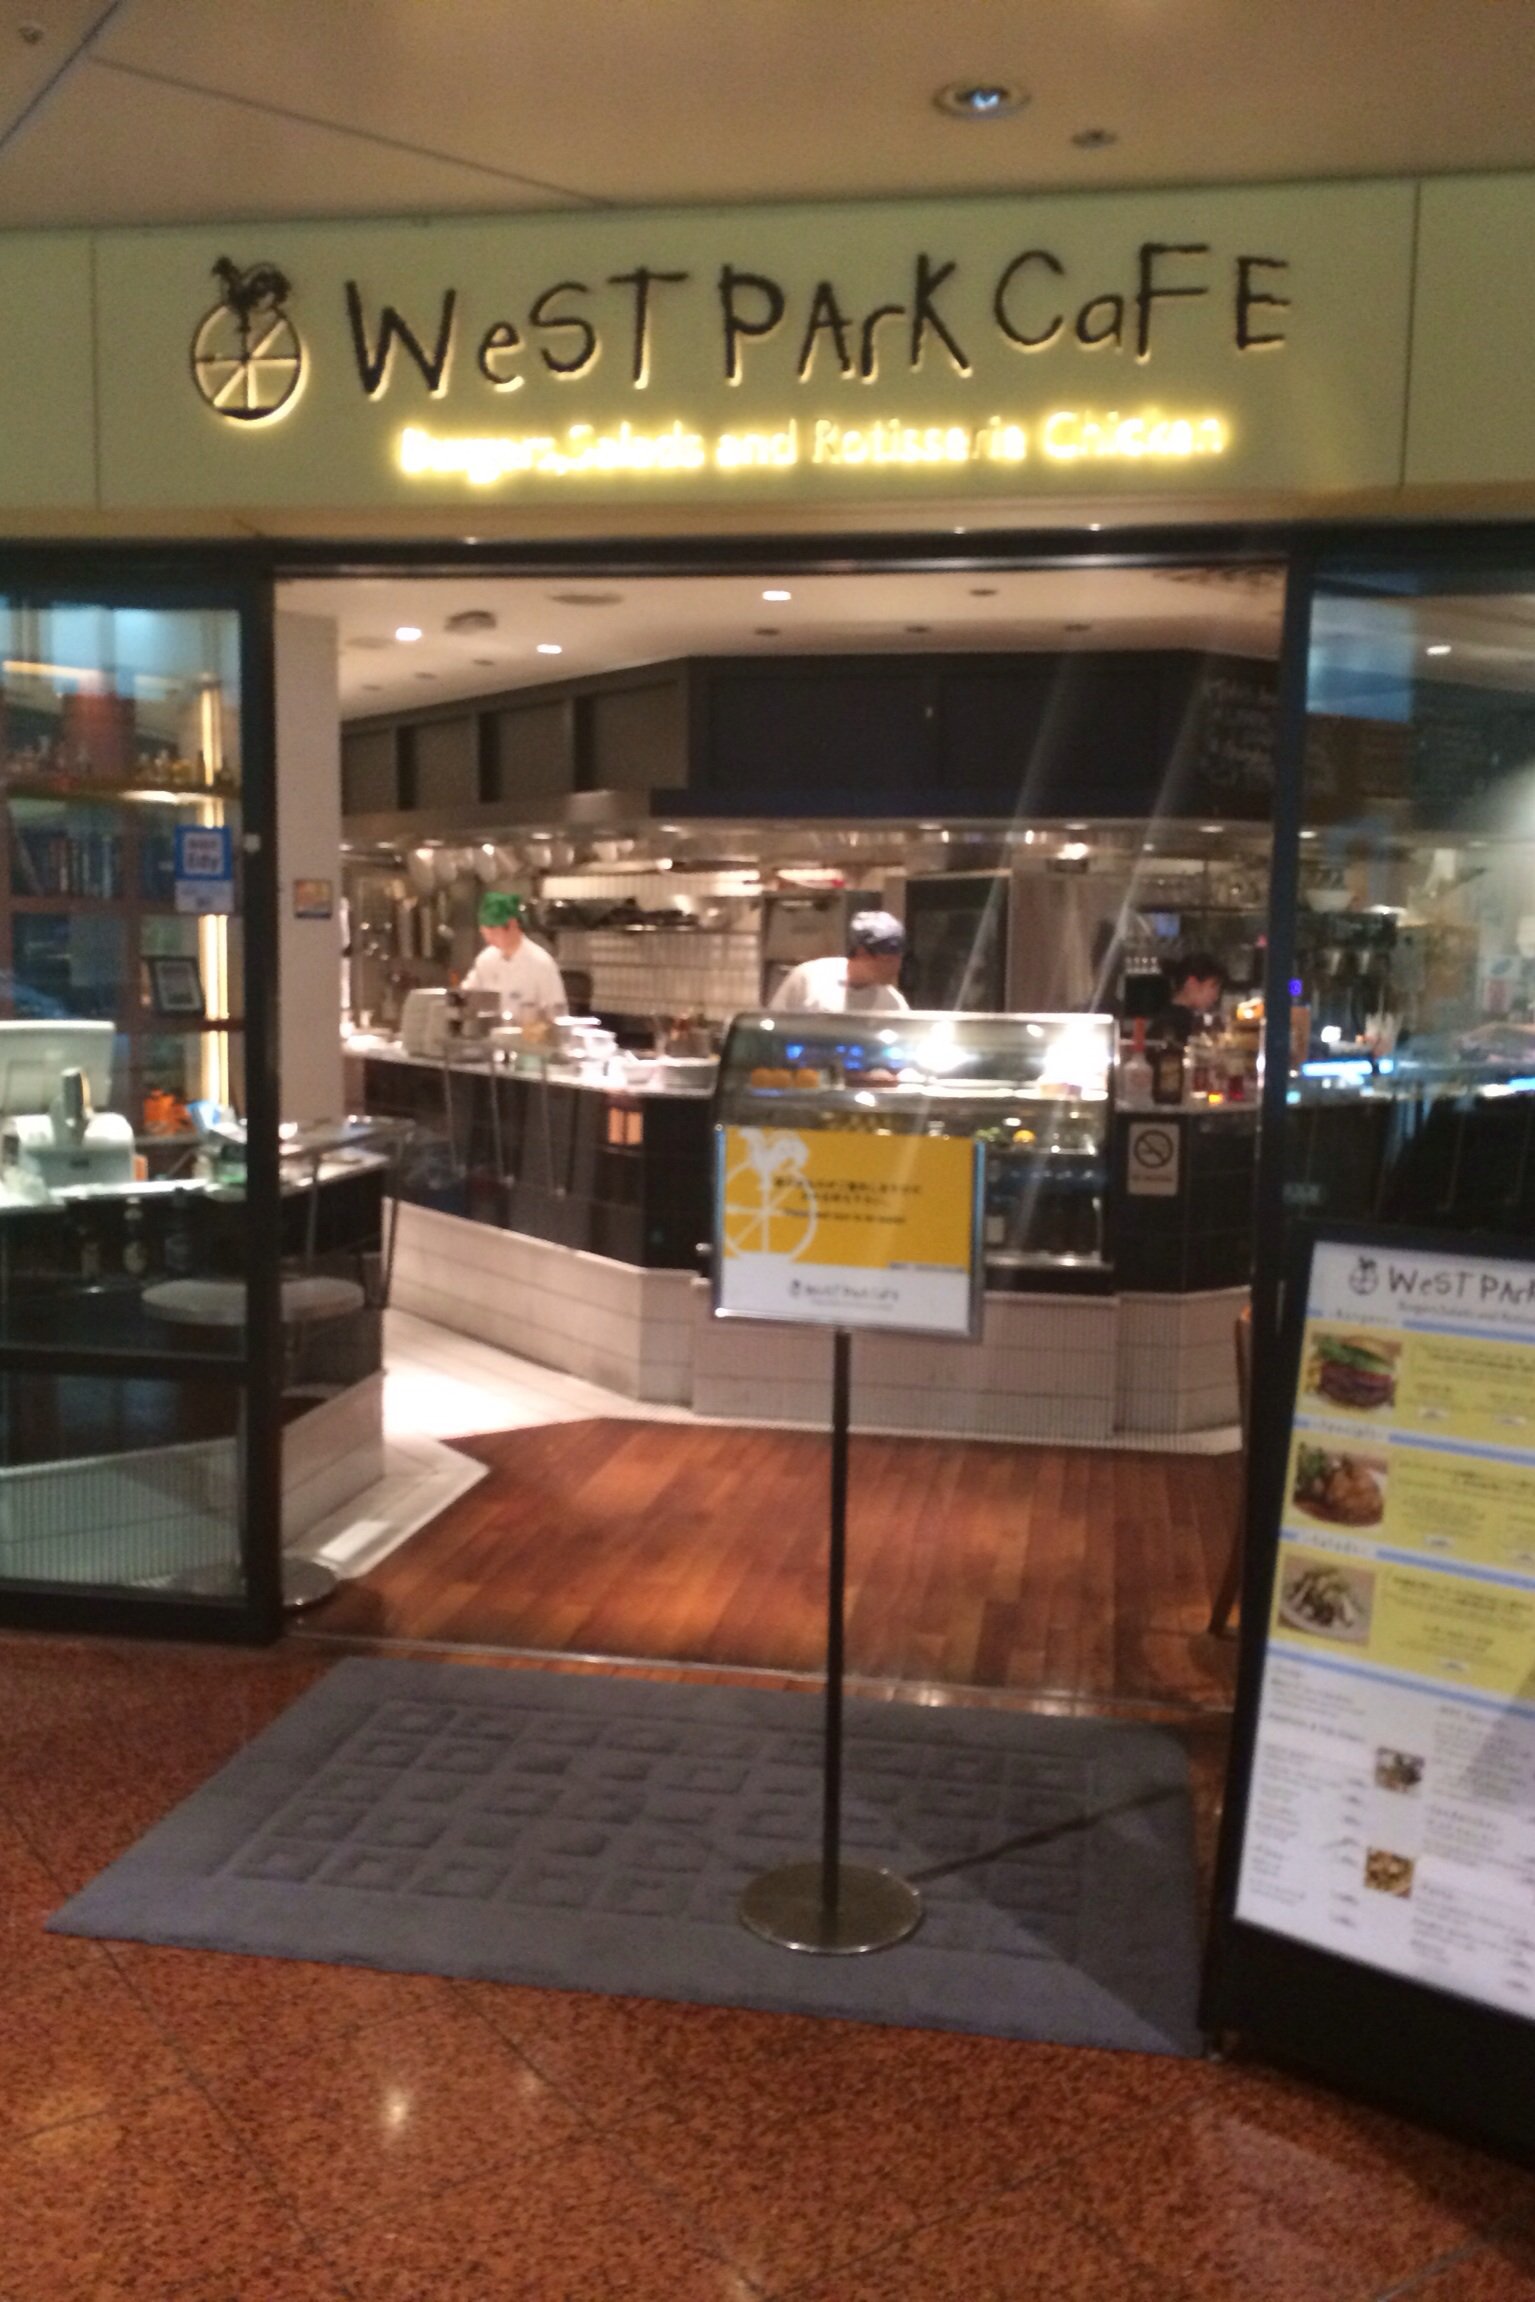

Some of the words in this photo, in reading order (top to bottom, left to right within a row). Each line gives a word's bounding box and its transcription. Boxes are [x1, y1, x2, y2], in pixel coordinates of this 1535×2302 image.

[345, 266, 689, 397] WeST
[718, 252, 972, 383] PArK
[993, 242, 1292, 361] CaFE
[714, 419, 798, 466] and
